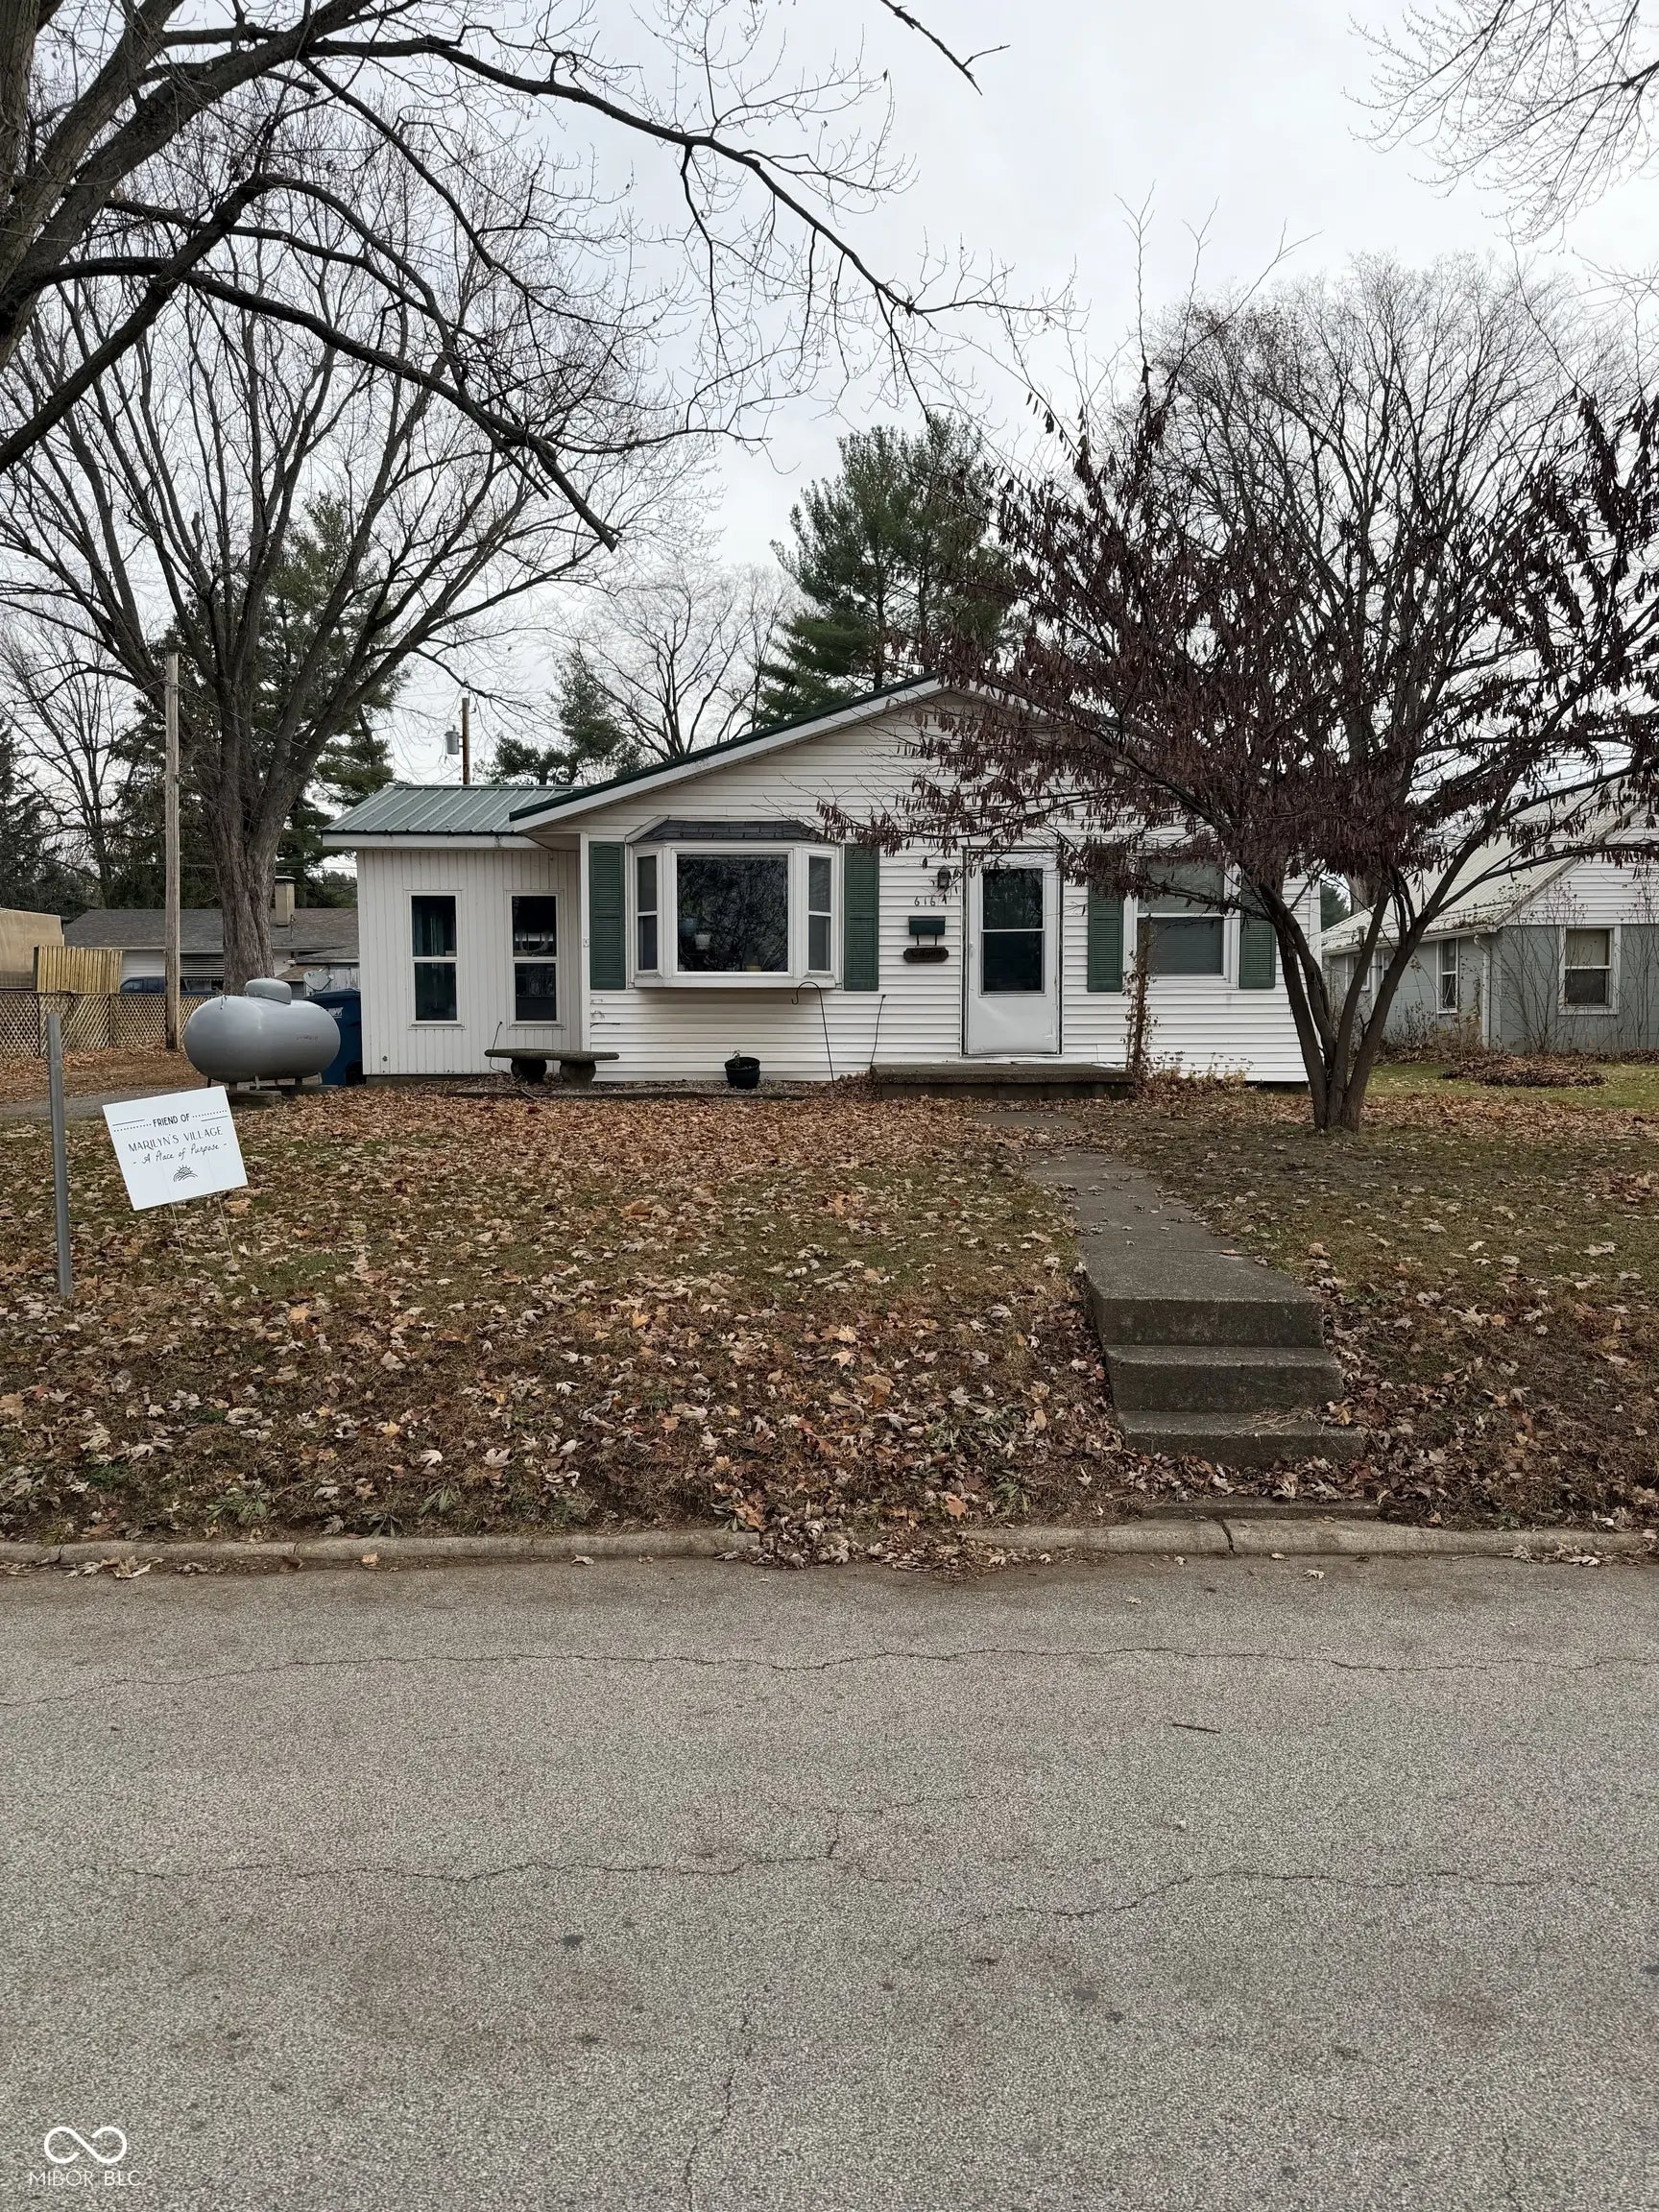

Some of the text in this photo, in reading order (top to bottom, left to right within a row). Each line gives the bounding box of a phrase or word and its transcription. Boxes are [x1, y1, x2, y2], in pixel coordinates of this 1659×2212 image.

[153, 1113, 190, 1127] FRIEND OF
[128, 1125, 223, 1152] MARILYN'S VILLAGE
[141, 1142, 220, 1164] A Place of Purpose
